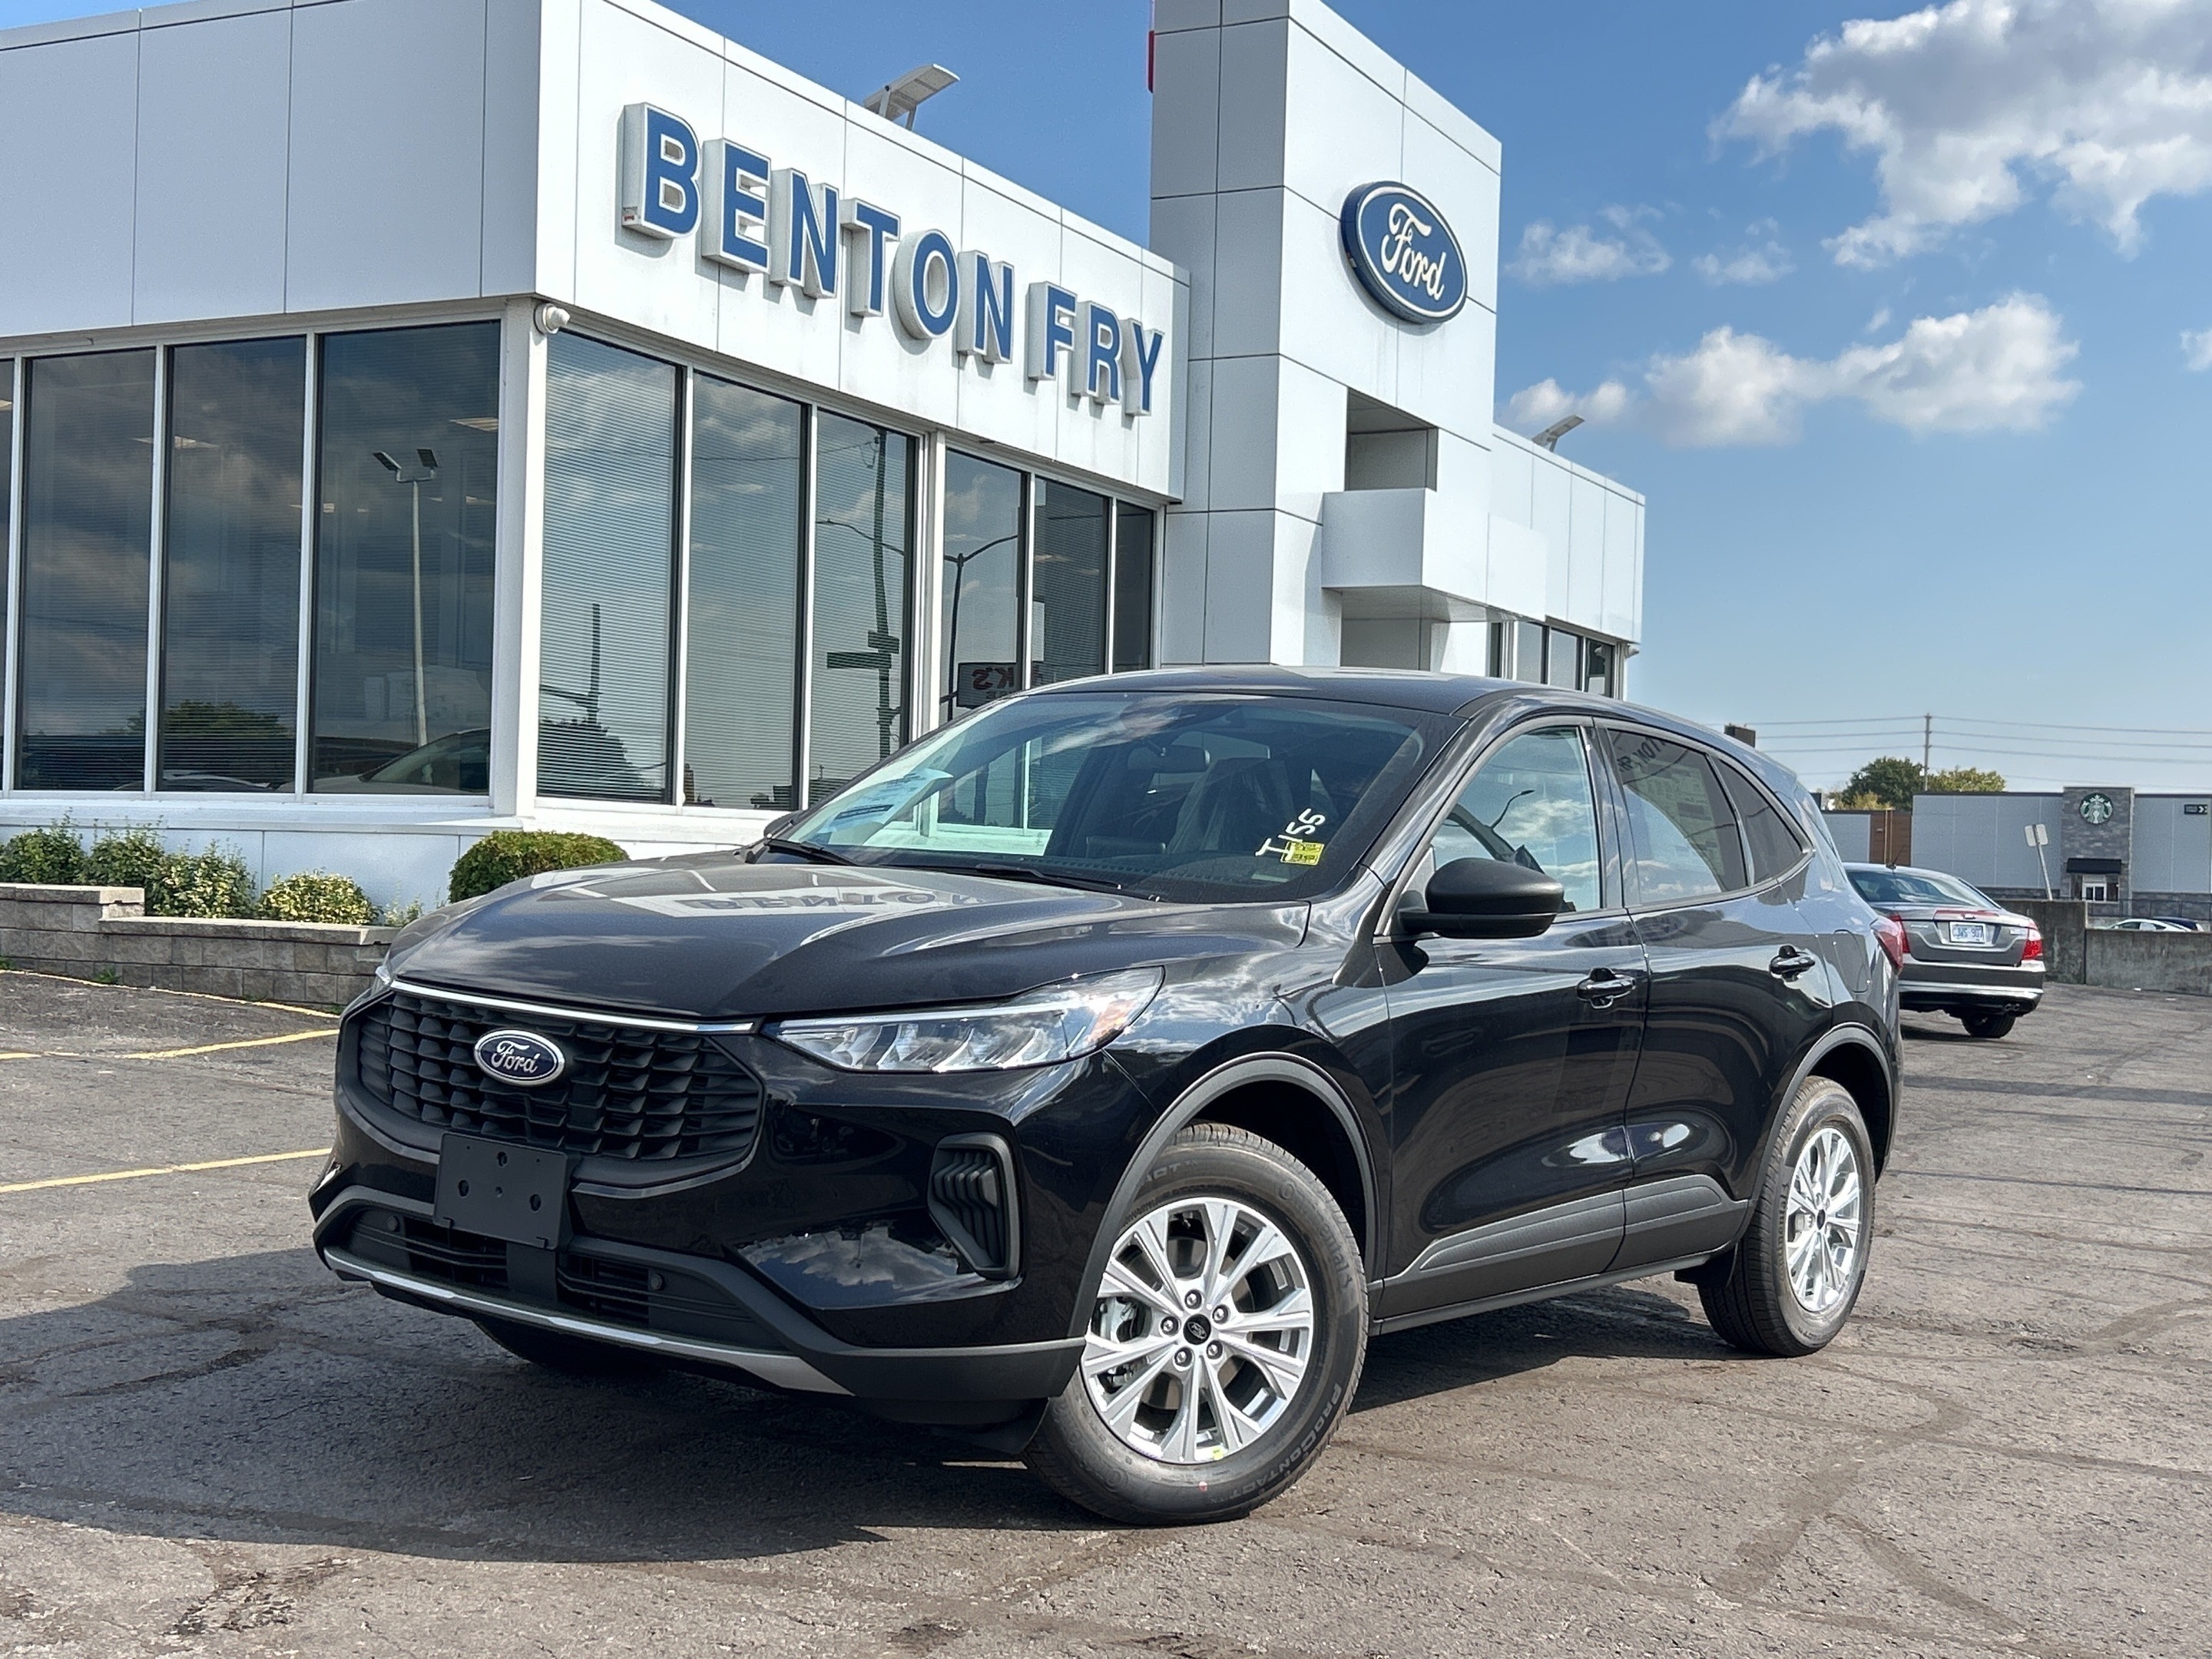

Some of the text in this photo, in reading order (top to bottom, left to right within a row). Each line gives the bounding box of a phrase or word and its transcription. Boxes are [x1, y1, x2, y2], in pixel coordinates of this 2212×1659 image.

[623, 102, 1165, 416] BENTON FRY
[1381, 203, 1447, 300] Ford
[491, 1040, 541, 1073] Ford
